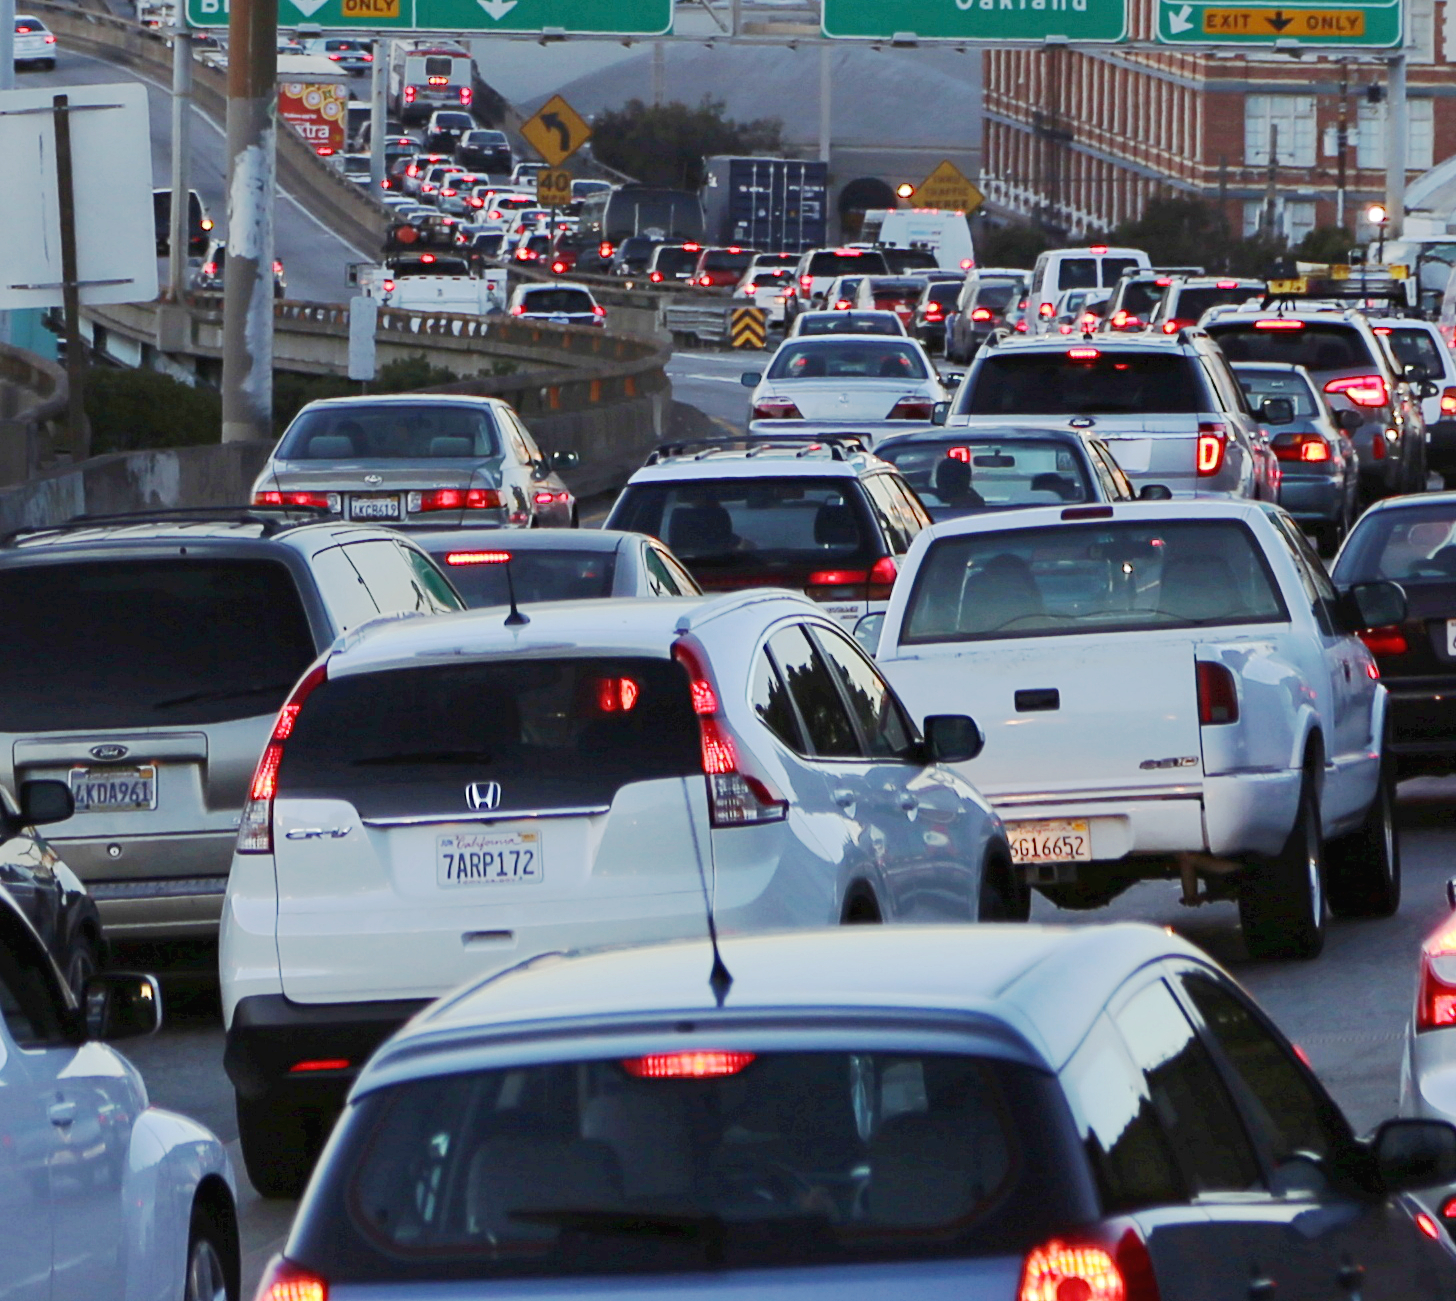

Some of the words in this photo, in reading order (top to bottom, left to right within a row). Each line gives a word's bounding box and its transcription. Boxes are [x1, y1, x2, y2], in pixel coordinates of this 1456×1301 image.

[1205, 13, 1251, 31] EXIT
[1305, 14, 1359, 32] ONLY
[540, 173, 569, 192] 40
[75, 780, 152, 804] 4KDA961
[285, 826, 353, 841] CR-V
[455, 833, 522, 851] California
[443, 850, 536, 880] 7ARP172
